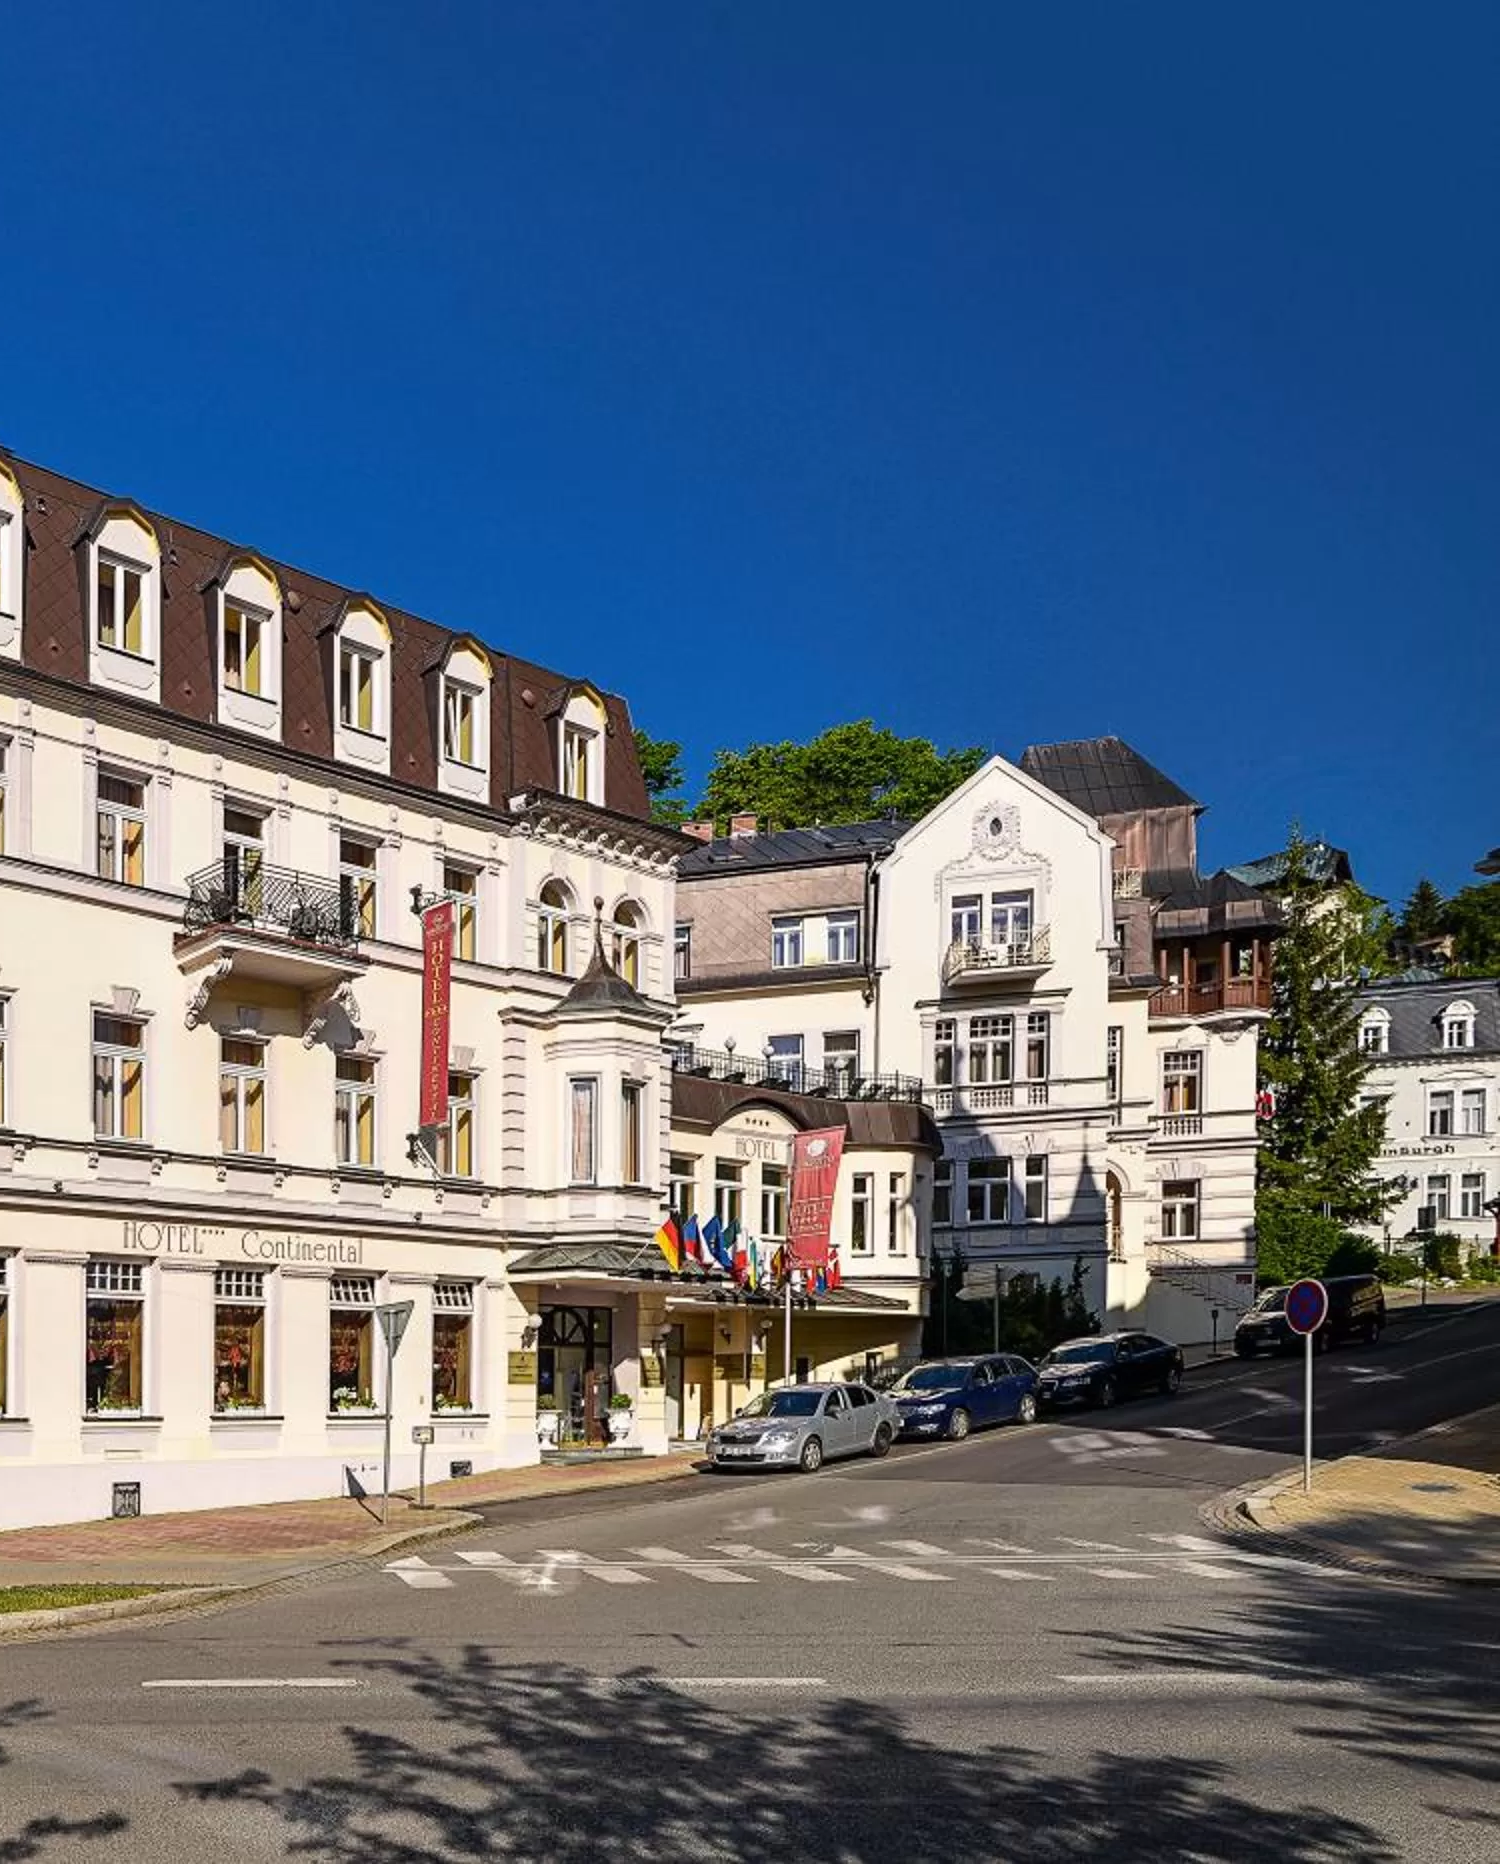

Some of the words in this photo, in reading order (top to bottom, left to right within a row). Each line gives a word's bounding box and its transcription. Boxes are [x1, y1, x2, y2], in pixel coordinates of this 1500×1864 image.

[431, 938, 444, 1004] HOTEL
[735, 1136, 778, 1161] HOTEL
[122, 1221, 203, 1254] HOTEL
[241, 1230, 364, 1264] Continental
